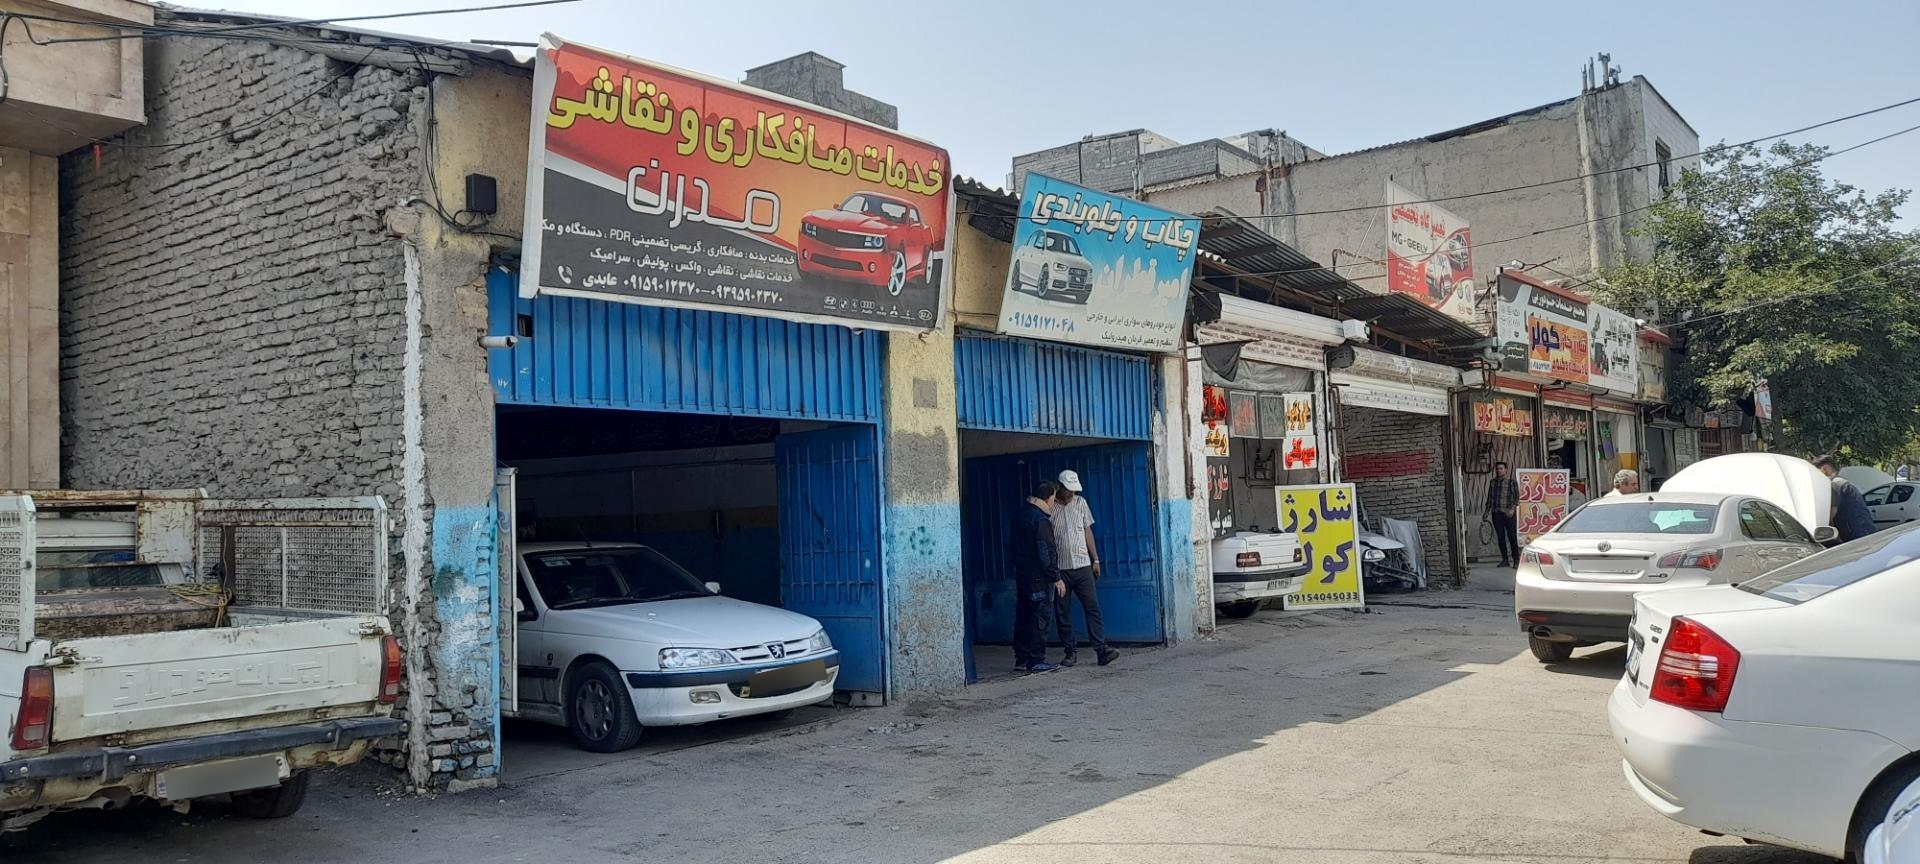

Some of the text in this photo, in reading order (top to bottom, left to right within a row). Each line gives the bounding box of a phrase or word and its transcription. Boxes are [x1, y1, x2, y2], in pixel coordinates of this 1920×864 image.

[546, 66, 944, 196] خدمات صافکاری و نقاشی
[626, 158, 781, 235] مدرن
[557, 224, 564, 236] و
[565, 222, 603, 238] دستگاه
[1030, 191, 1195, 263] چکاب و جلوبندی
[632, 234, 670, 248] تضمینی
[670, 240, 702, 254] گریسی
[589, 247, 631, 264] سرامیک
[768, 253, 795, 265] خدمات
[582, 273, 618, 289] عابدی
[766, 271, 793, 283] خدمات
[1009, 311, 1075, 333] ۰۹۱۵۹۱۷۱۰۴۸
[1531, 321, 1560, 353] کولر
[1519, 472, 1567, 502] شارژ
[1284, 490, 1352, 532] شارژ
[1519, 504, 1567, 535] کولر
[1302, 541, 1353, 583] کول
[1287, 591, 1358, 604] 09154045033
